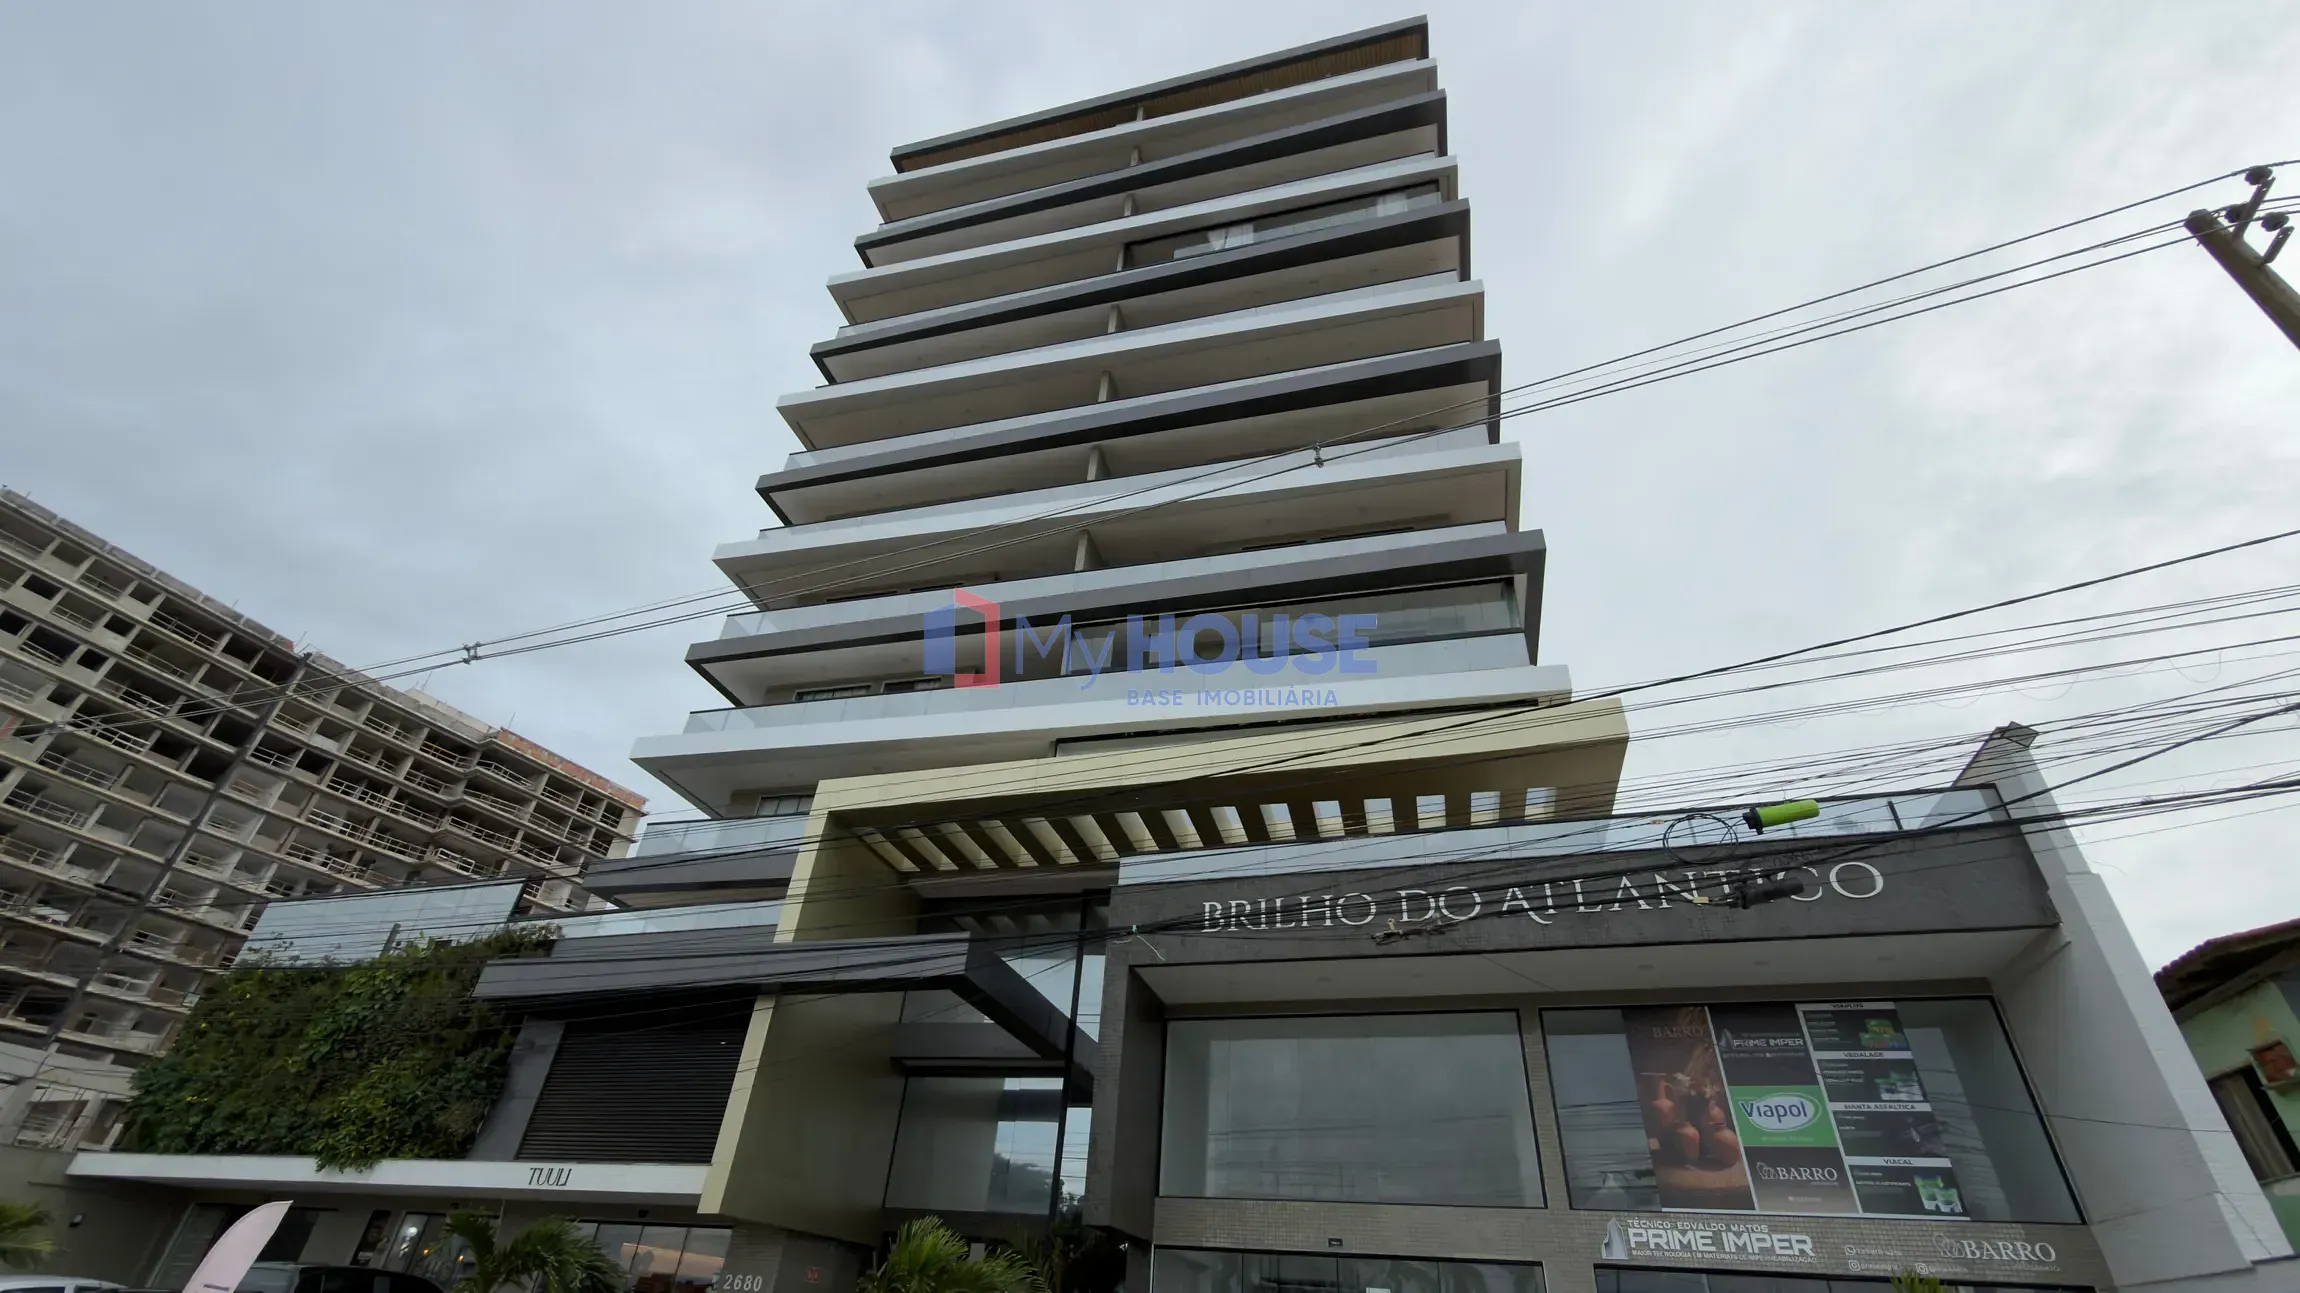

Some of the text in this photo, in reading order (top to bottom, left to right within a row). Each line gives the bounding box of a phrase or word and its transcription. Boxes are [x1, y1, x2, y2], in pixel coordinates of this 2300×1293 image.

[1201, 892, 1377, 933] BRILHO
[1397, 886, 1481, 923] DO
[1652, 1026, 1704, 1038] BARRO
[1733, 1039, 1768, 1047] PRIME
[1769, 1038, 1804, 1046] IMPER
[1740, 1101, 1808, 1123] Viapol
[1777, 1167, 1838, 1180] BARRO
[1677, 1221, 1726, 1231] EDVALDO
[1730, 1223, 1769, 1233] MATOS
[1627, 1228, 1816, 1257] PRIME IMPER
[1632, 1249, 1652, 1257] MAIOR
[1653, 1250, 1692, 1258] TECNOLOGIA
[1961, 1240, 2056, 1262] BARRO
[723, 1274, 763, 1292] 2680
